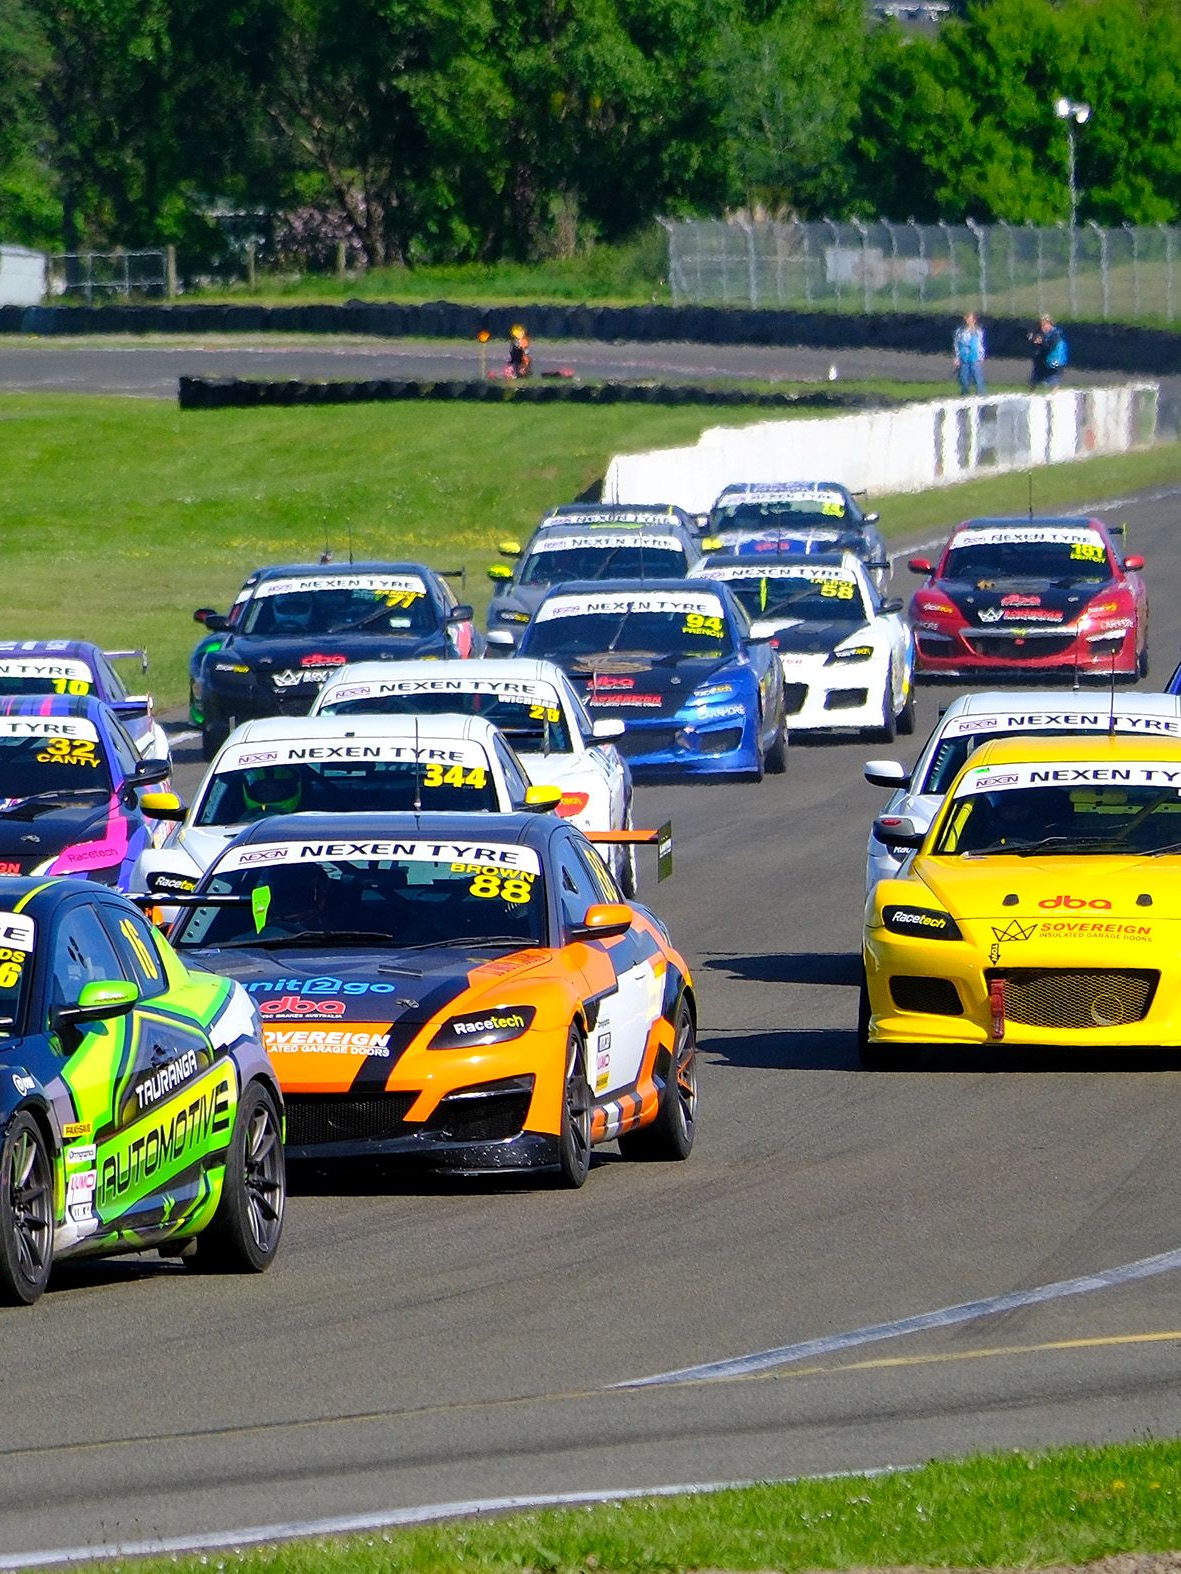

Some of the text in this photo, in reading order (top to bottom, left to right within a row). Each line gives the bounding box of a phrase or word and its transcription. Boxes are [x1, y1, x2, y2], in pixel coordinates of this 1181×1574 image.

[572, 538, 671, 547] NEXEN TYRE
[1052, 534, 1091, 543] TYRE
[1071, 544, 1104, 558] 181
[732, 569, 842, 577] NEXEN TYRE
[300, 579, 414, 589] NEXEN TYRE
[821, 586, 854, 600] 58
[587, 602, 706, 612] NEXEN TYRE
[686, 614, 722, 631] 94
[17, 666, 76, 676] TYRE
[51, 678, 90, 696] 10
[379, 681, 536, 695] NEXEN TYRE
[530, 705, 560, 723] 28
[7, 723, 76, 736] TYRE
[1008, 715, 1179, 732] NEXEN TYRE
[47, 738, 96, 758] 32
[288, 746, 464, 762] NEXEN TYRE
[37, 754, 100, 768] CANTY
[424, 764, 487, 789] 344
[1030, 770, 1130, 782] NEXEN
[68, 847, 118, 863] Racetech
[300, 843, 519, 864] NEXEN TYRE
[451, 862, 535, 883] BROWN
[155, 876, 195, 891] Racete
[468, 874, 531, 904] 88
[1038, 896, 1112, 910] dba
[892, 911, 947, 929] Racetech
[1040, 923, 1151, 934] SOVEREIGN
[990, 945, 999, 962] TOW
[259, 996, 346, 1013] dba
[454, 1015, 524, 1035] Racetech
[301, 1046, 348, 1054] GARAGE
[351, 1048, 389, 1057] DOORS
[135, 1049, 198, 1109] TAURANGA
[101, 1079, 229, 1206] AUTOMOTIVE
